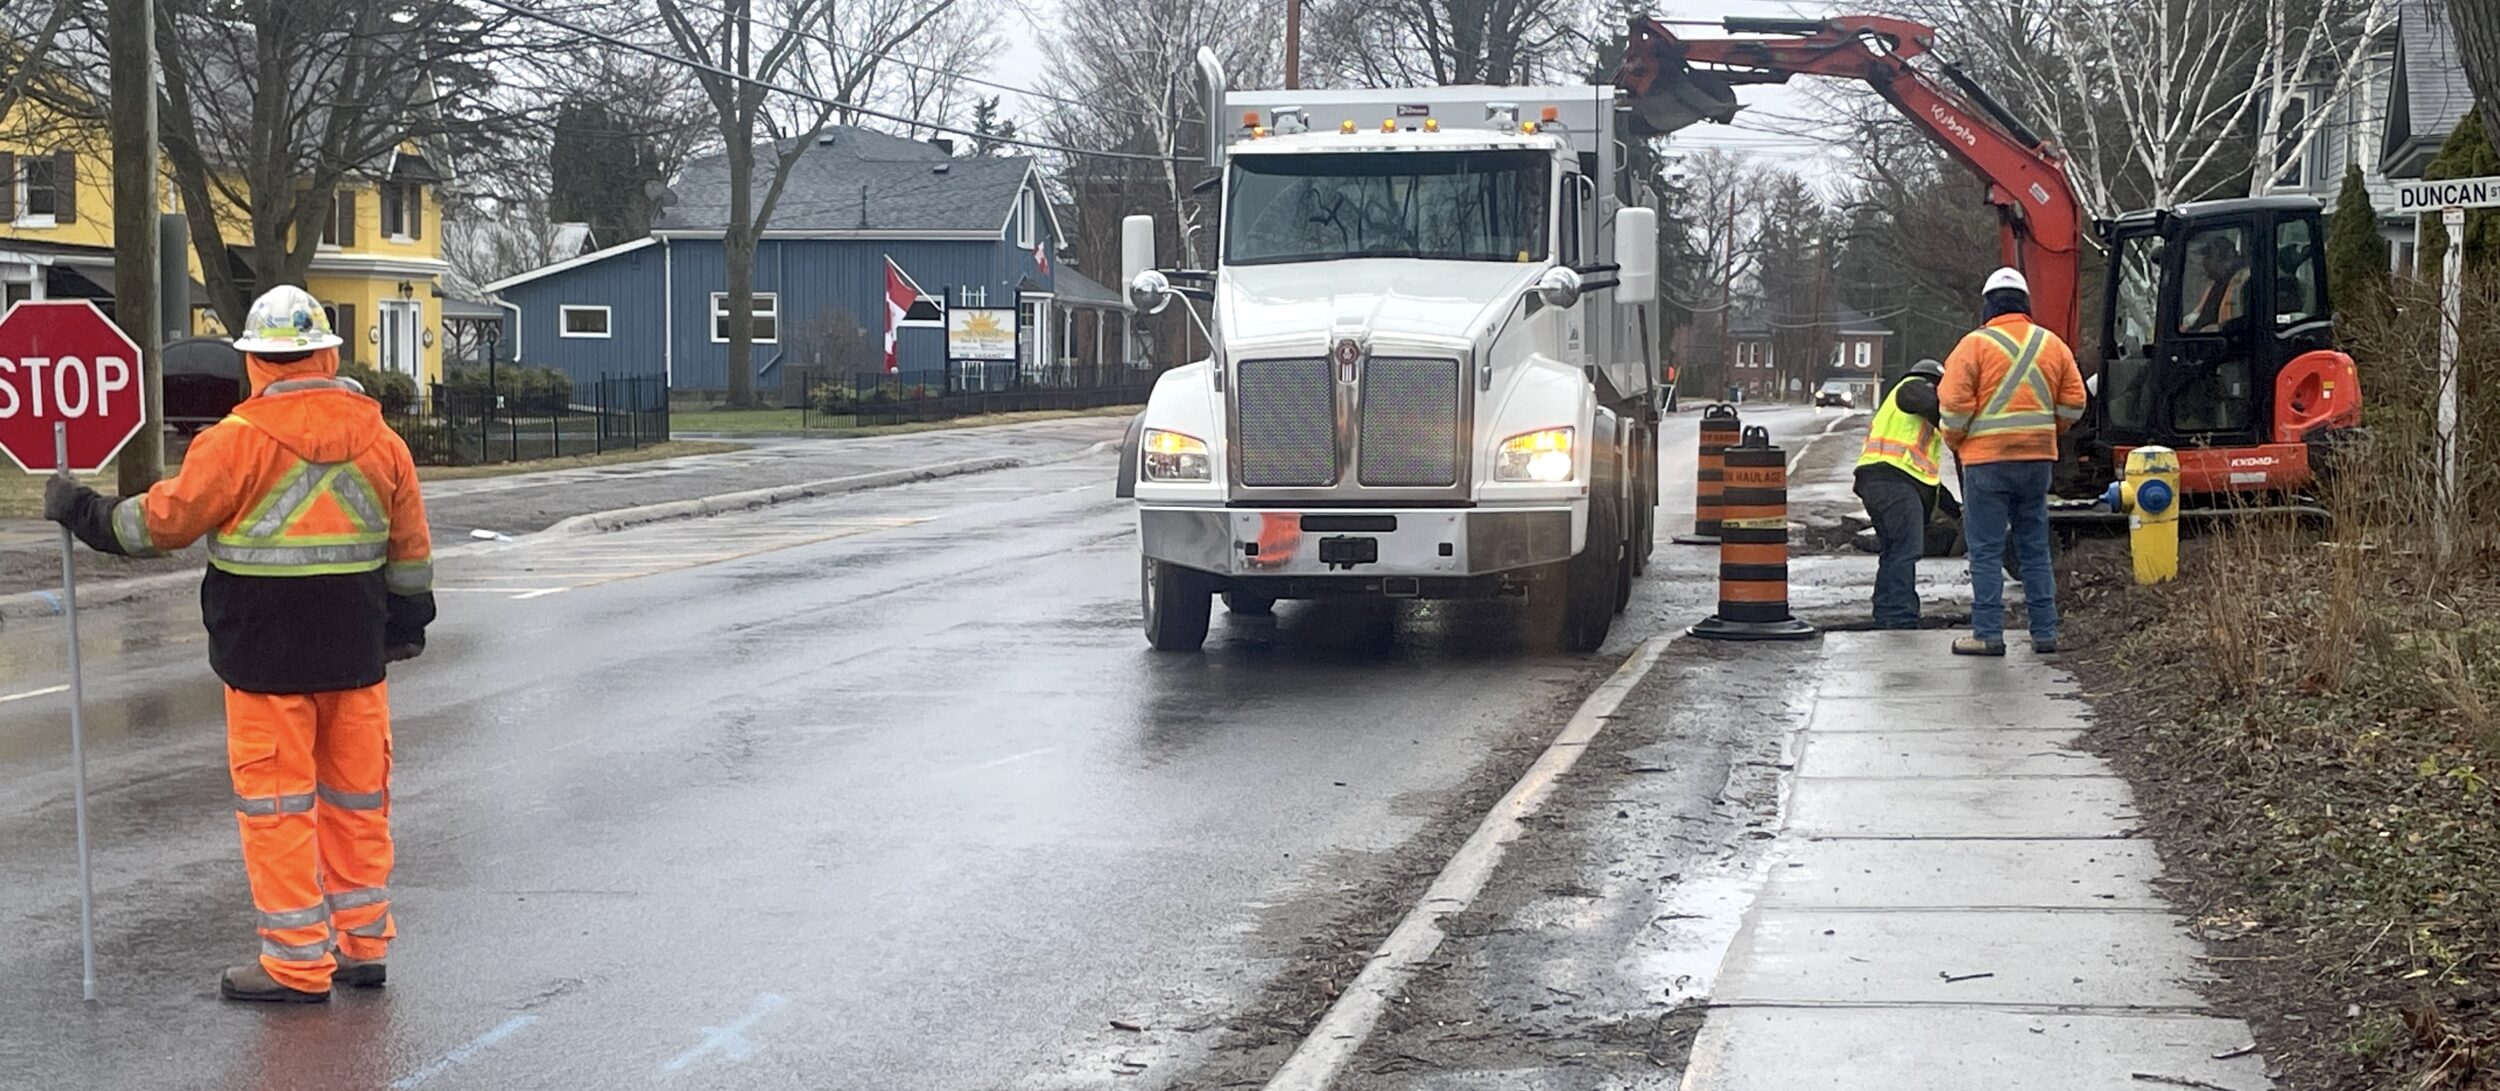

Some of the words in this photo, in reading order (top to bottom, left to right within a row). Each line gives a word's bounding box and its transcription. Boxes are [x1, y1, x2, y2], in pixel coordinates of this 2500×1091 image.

[1931, 104, 1976, 147] Kubota
[2402, 183, 2487, 207] DUNCAN
[0, 356, 130, 418] STOP
[1736, 470, 1782, 483] HAULAGE
